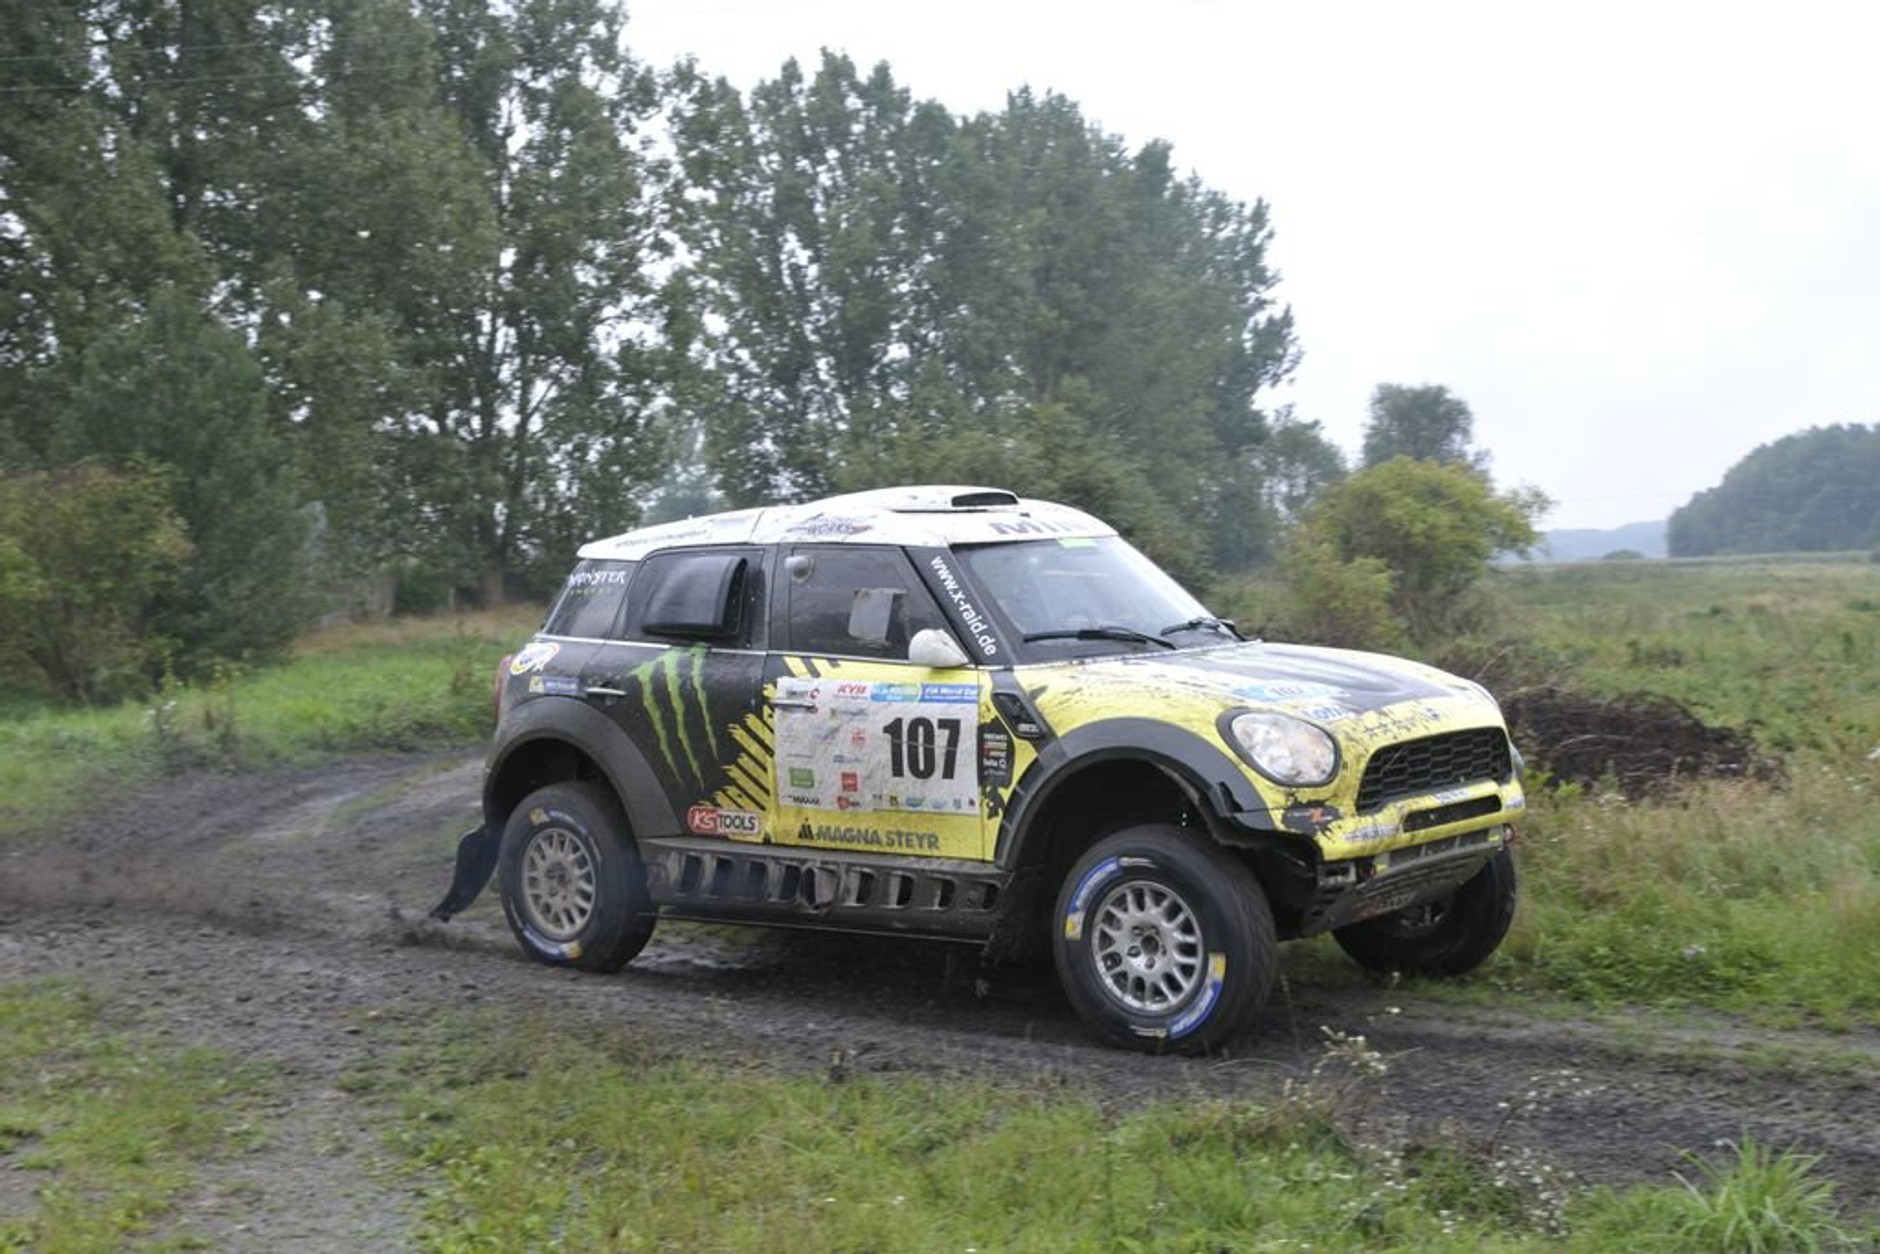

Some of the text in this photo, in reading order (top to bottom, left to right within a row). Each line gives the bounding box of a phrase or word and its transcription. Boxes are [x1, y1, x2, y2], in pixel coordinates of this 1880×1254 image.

[567, 570, 626, 587] MONSTER
[930, 556, 997, 656] www.x-raid.de
[883, 716, 962, 780] 107
[693, 810, 757, 832] KS TOOLS
[816, 824, 940, 850] MAGNA STEYR
